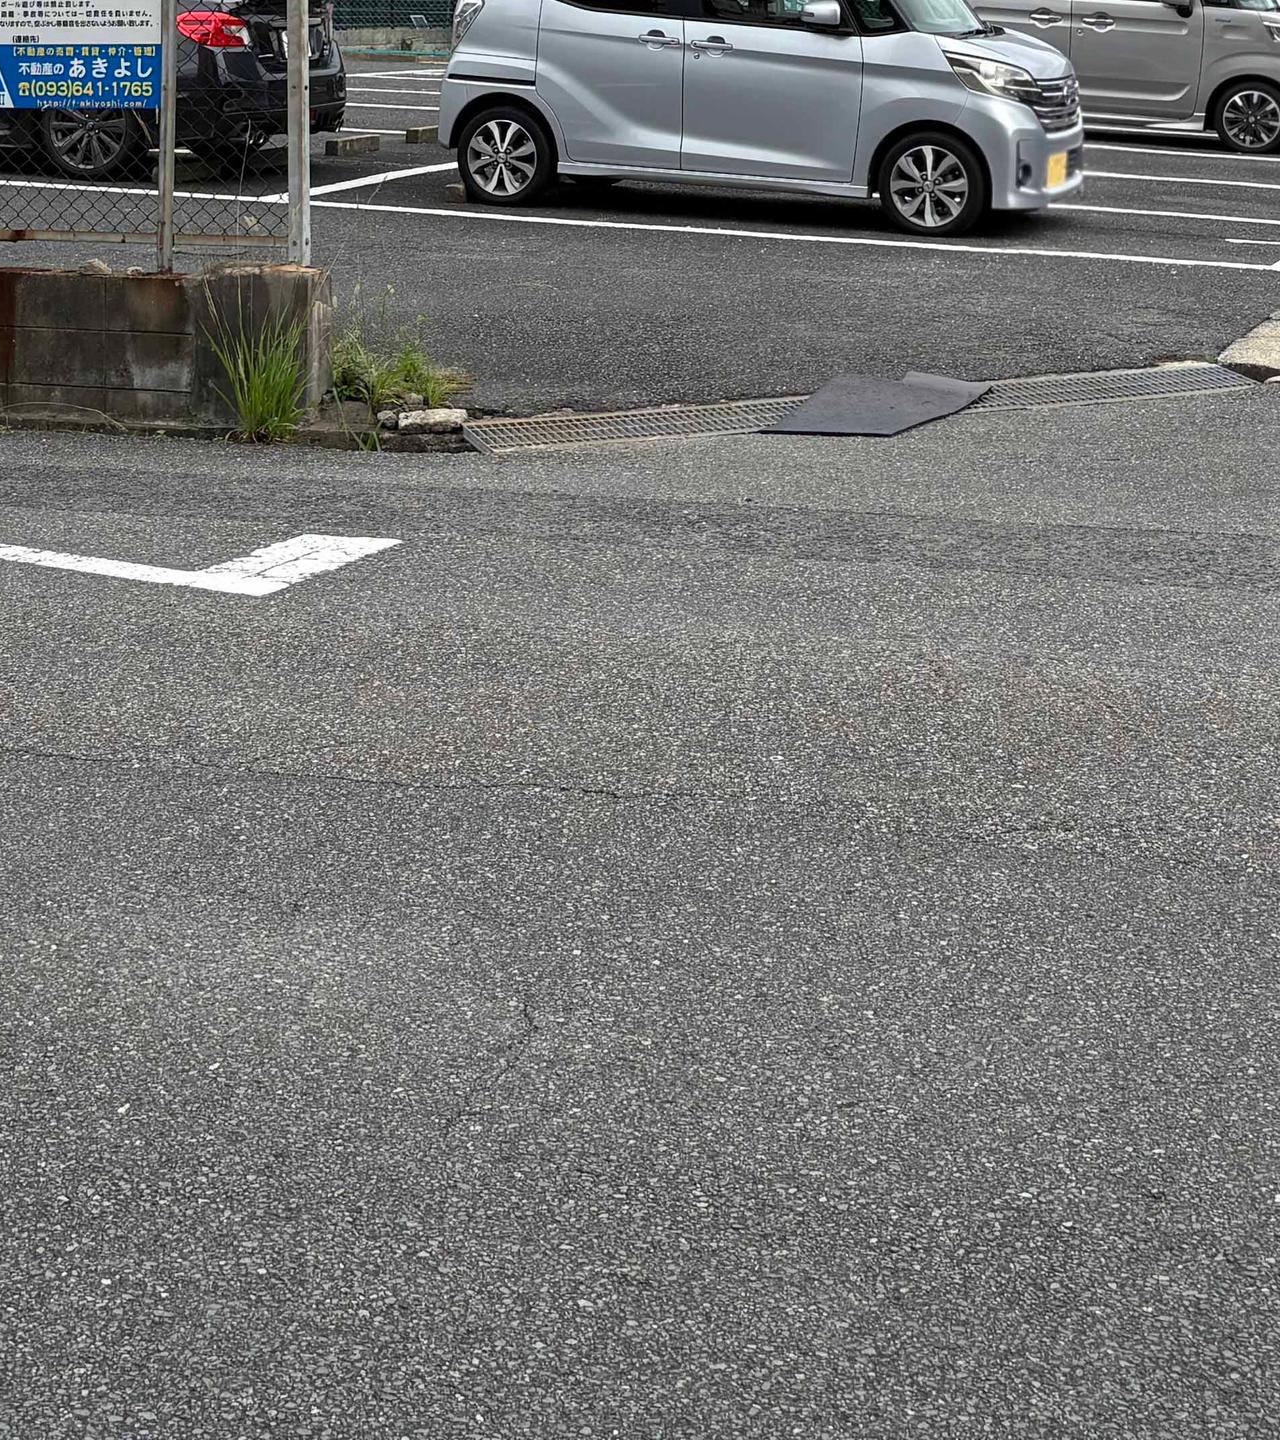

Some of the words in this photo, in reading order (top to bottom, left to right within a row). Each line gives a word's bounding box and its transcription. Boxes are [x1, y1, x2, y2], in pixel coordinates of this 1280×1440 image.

[18, 57, 153, 79] 不動産のあきよし
